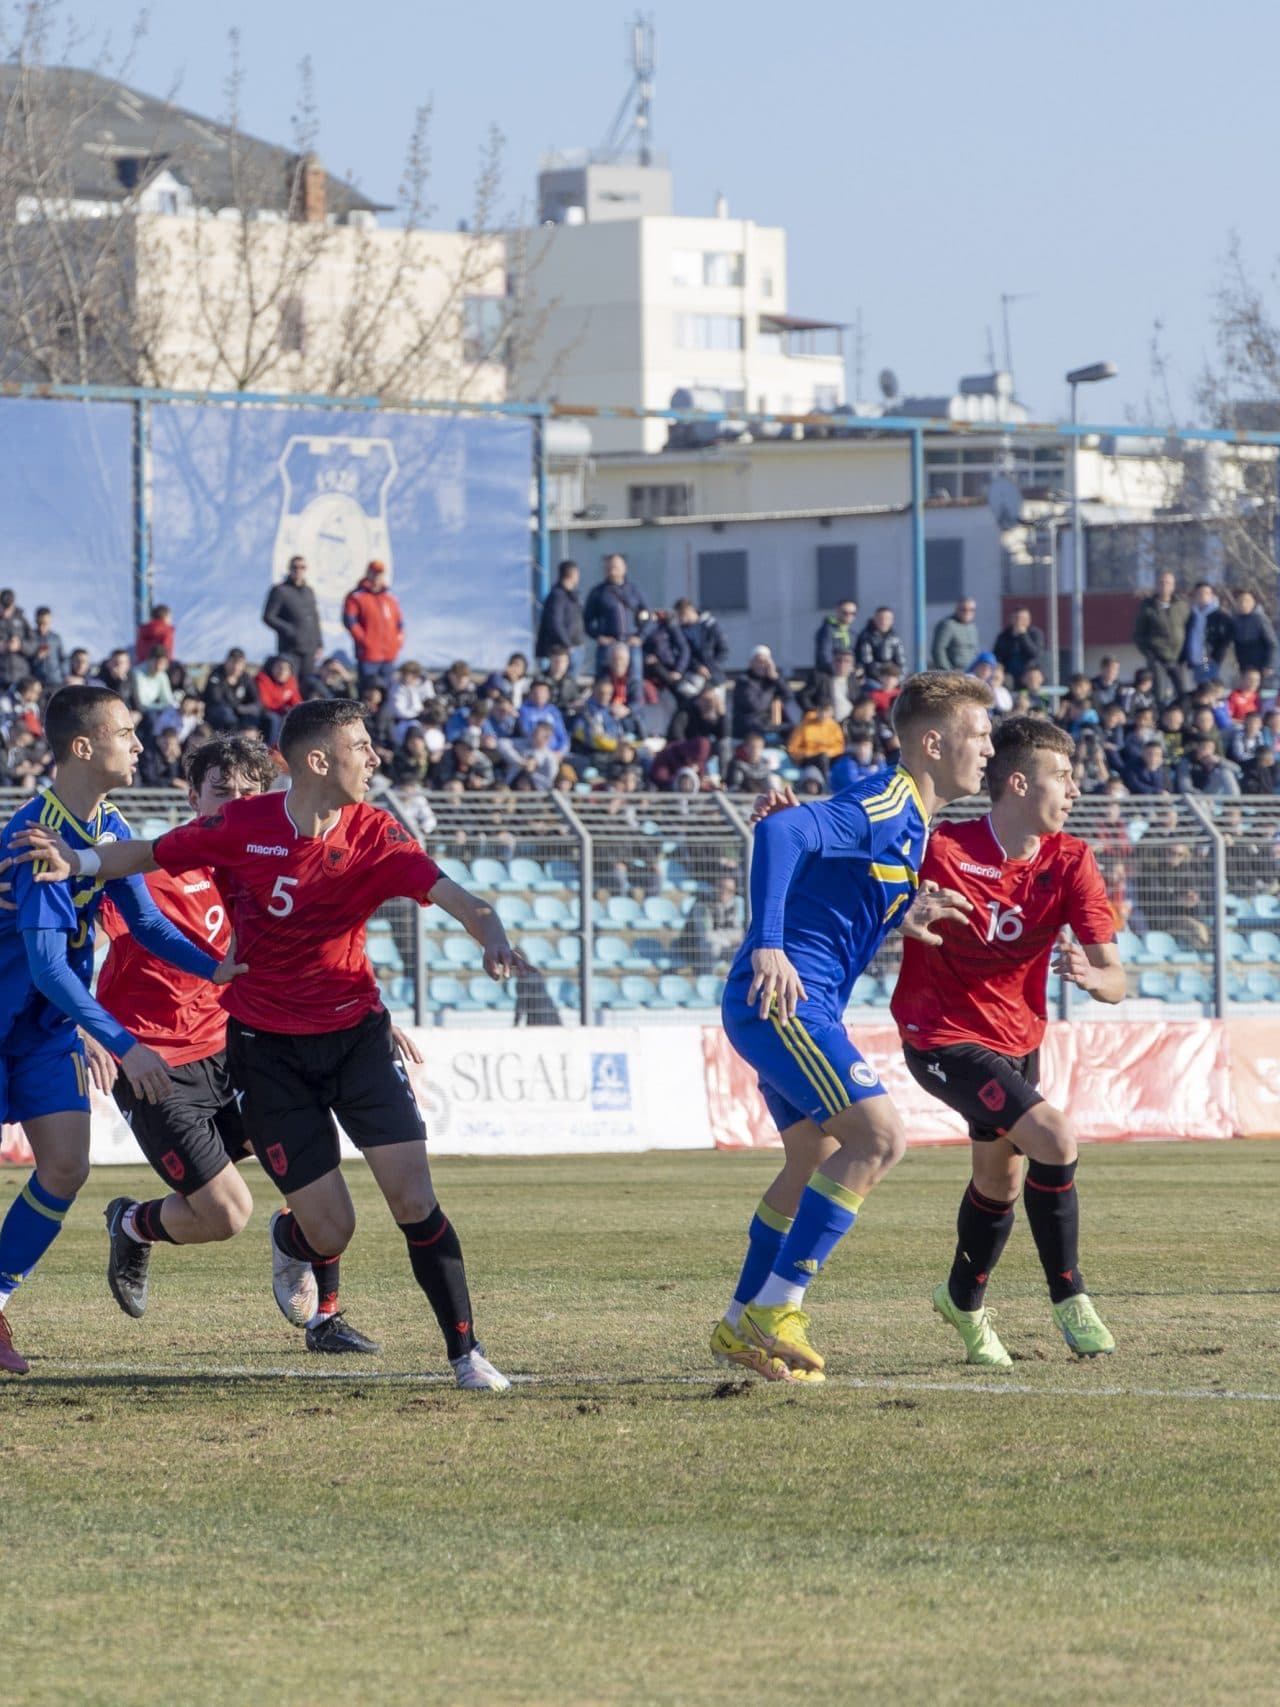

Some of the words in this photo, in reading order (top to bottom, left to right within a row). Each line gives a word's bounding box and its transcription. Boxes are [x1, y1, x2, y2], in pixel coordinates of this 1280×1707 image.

[246, 843, 289, 857] macron
[960, 861, 1002, 879] macron
[267, 875, 299, 917] 5
[204, 904, 224, 943] 9
[986, 901, 1024, 942] 16
[451, 1051, 588, 1102] SIGAL
